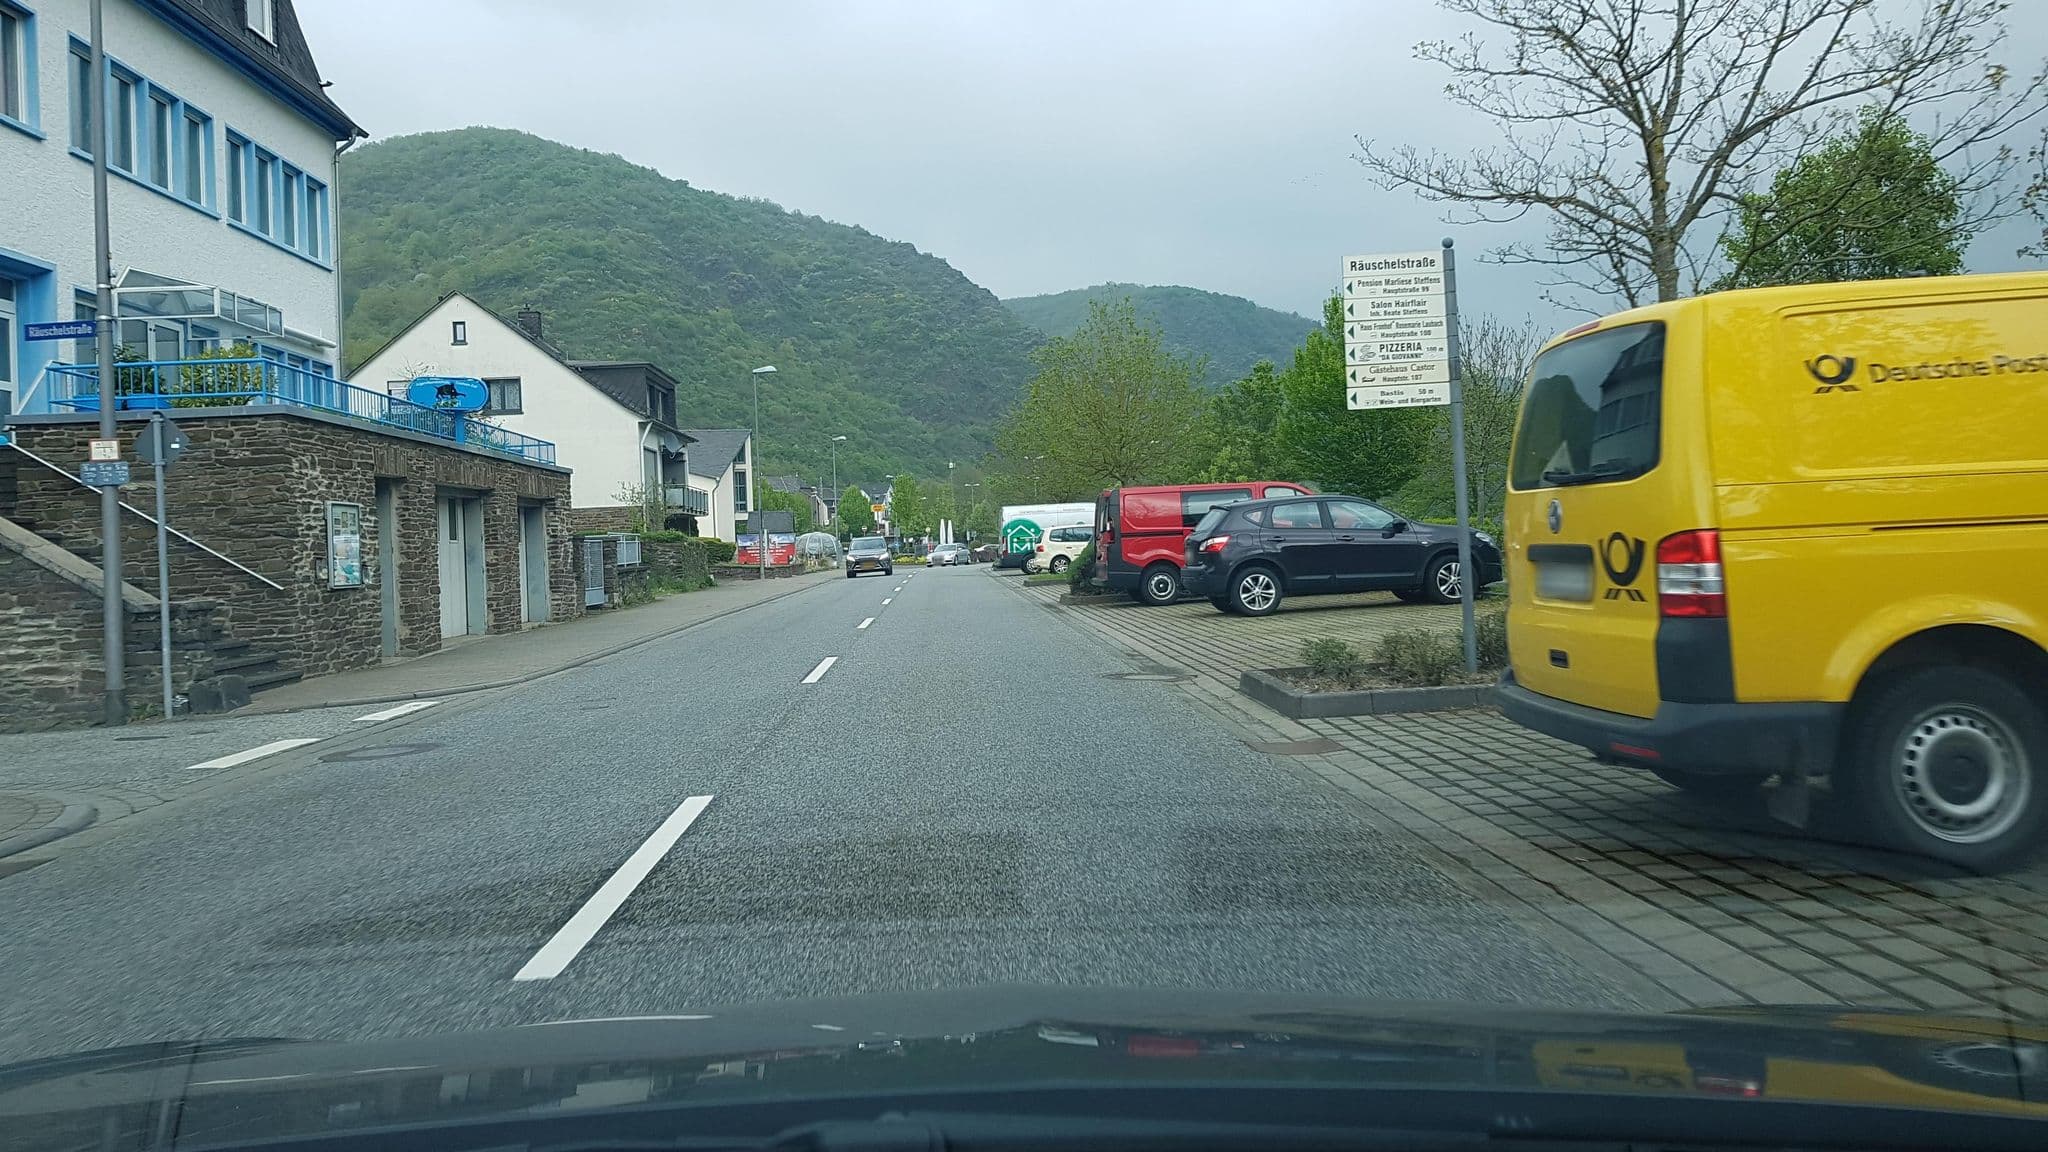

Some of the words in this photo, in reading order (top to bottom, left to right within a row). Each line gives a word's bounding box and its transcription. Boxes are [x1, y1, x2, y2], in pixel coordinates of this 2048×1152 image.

[1350, 257, 1436, 271] Räuschelstraße
[1357, 279, 1383, 287] Pension
[1382, 286, 1420, 295] Hauptstraße
[1370, 301, 1393, 309] Salon
[1394, 299, 1427, 308] Hairflair
[28, 323, 93, 337] Räuschelstraße
[1380, 330, 1418, 339] Hauptstraße
[1379, 342, 1423, 353] PIZZERIA
[1369, 365, 1408, 374] Gästehaus
[1410, 363, 1436, 372] Castor
[1867, 356, 1992, 384] Deutsche
[1992, 353, 2048, 375] Post
